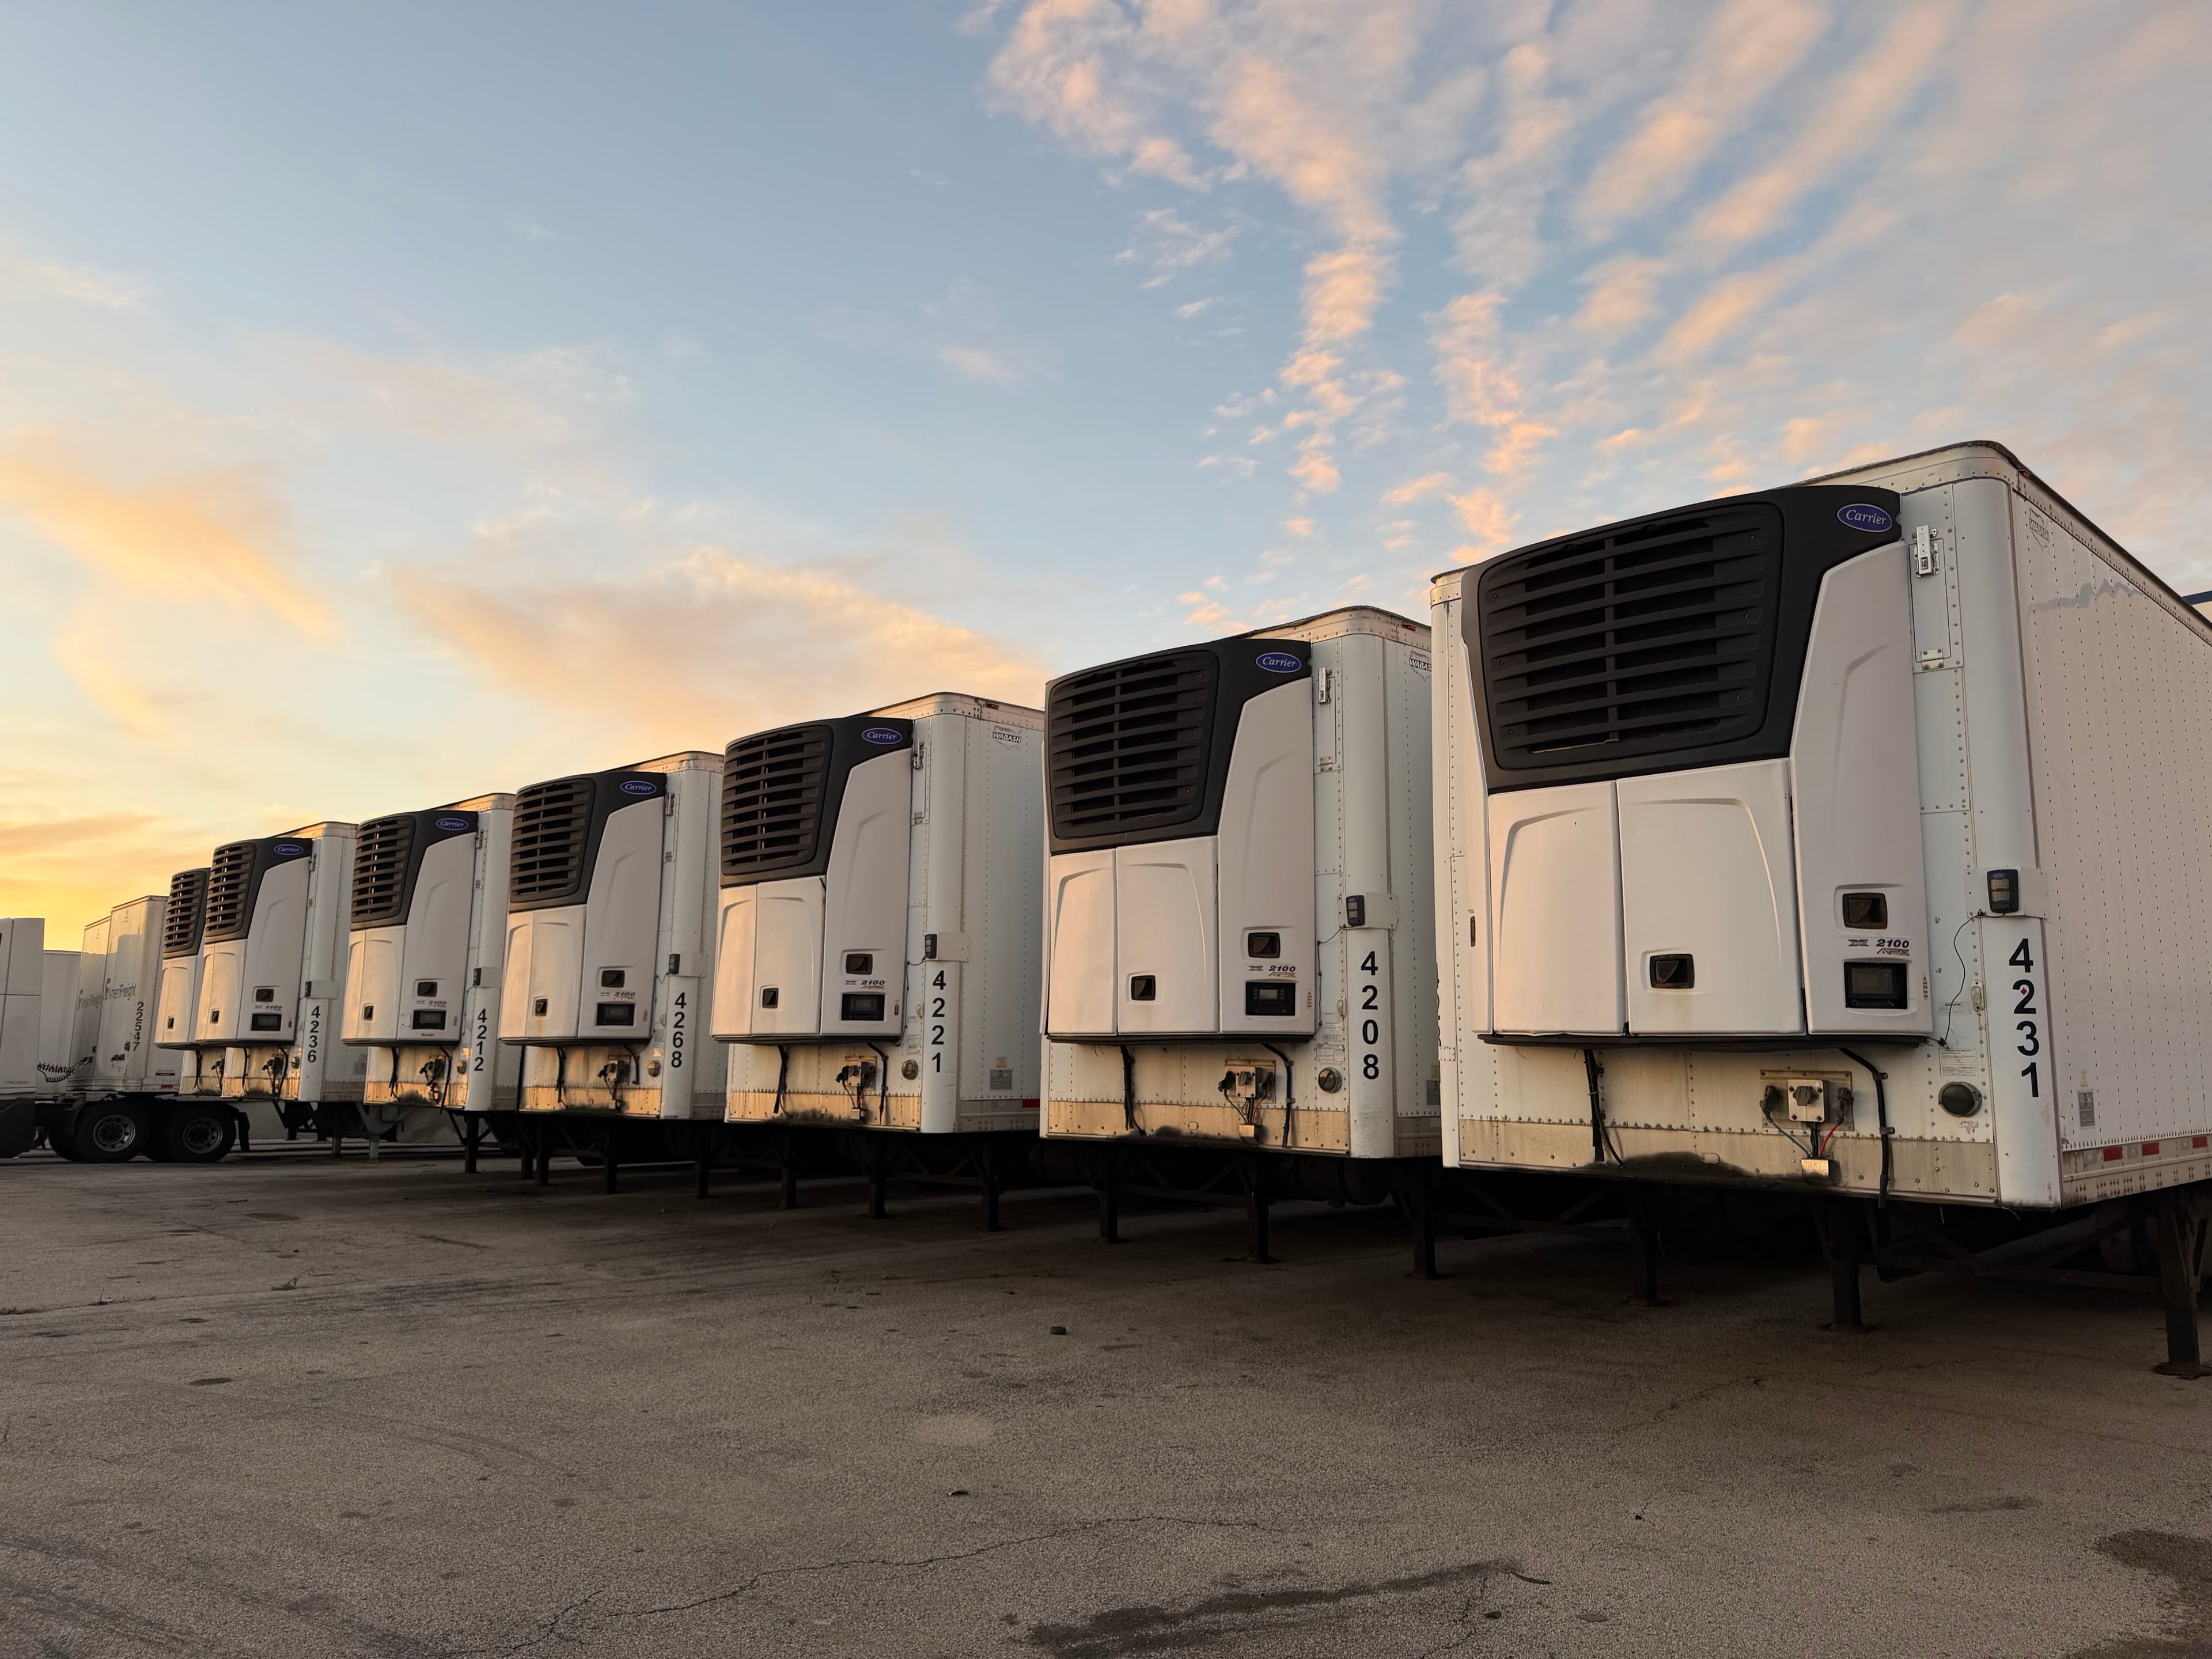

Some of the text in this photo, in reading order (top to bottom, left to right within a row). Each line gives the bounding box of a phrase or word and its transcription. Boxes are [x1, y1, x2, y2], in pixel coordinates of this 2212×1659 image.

[1846, 509, 1887, 525] Carrier
[2029, 518, 2050, 541] WABASH
[1262, 657, 1296, 667] Carrier
[1409, 658, 1432, 672] WABAS
[867, 731, 897, 740] Carrier
[993, 732, 1021, 743] WABASH
[1876, 939, 1910, 948] 2100
[1877, 948, 1910, 956] APX
[133, 1001, 144, 1051] 22547
[931, 970, 946, 1073] 4221
[1361, 951, 1380, 1080] 4208
[2009, 938, 2040, 1097] 4231
[308, 1005, 321, 1063] 4236
[474, 1009, 487, 1071] 4212
[671, 992, 687, 1068] 4268
